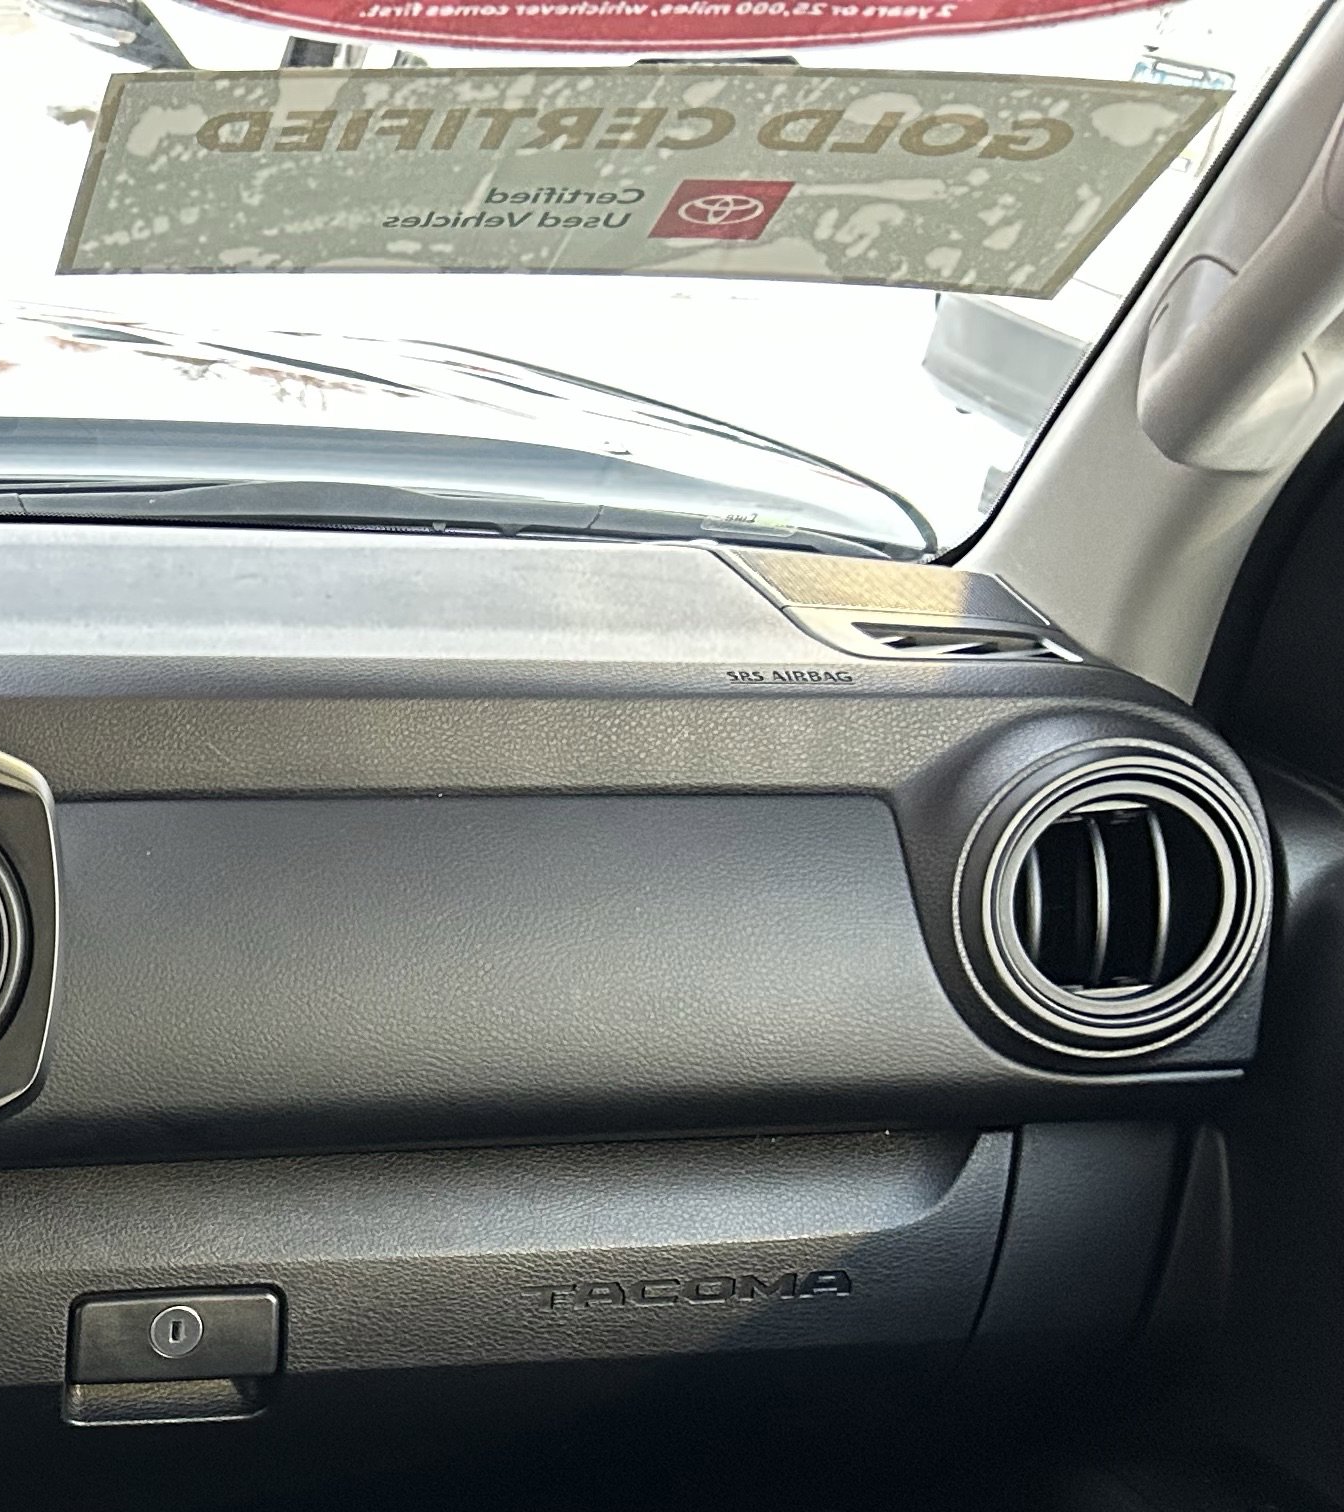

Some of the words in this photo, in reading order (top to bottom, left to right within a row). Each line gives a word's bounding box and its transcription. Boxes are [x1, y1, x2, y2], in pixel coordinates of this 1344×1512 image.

[726, 671, 764, 682] SRS
[772, 670, 853, 682] AIRBAG
[518, 1270, 852, 1308] TACOMA
